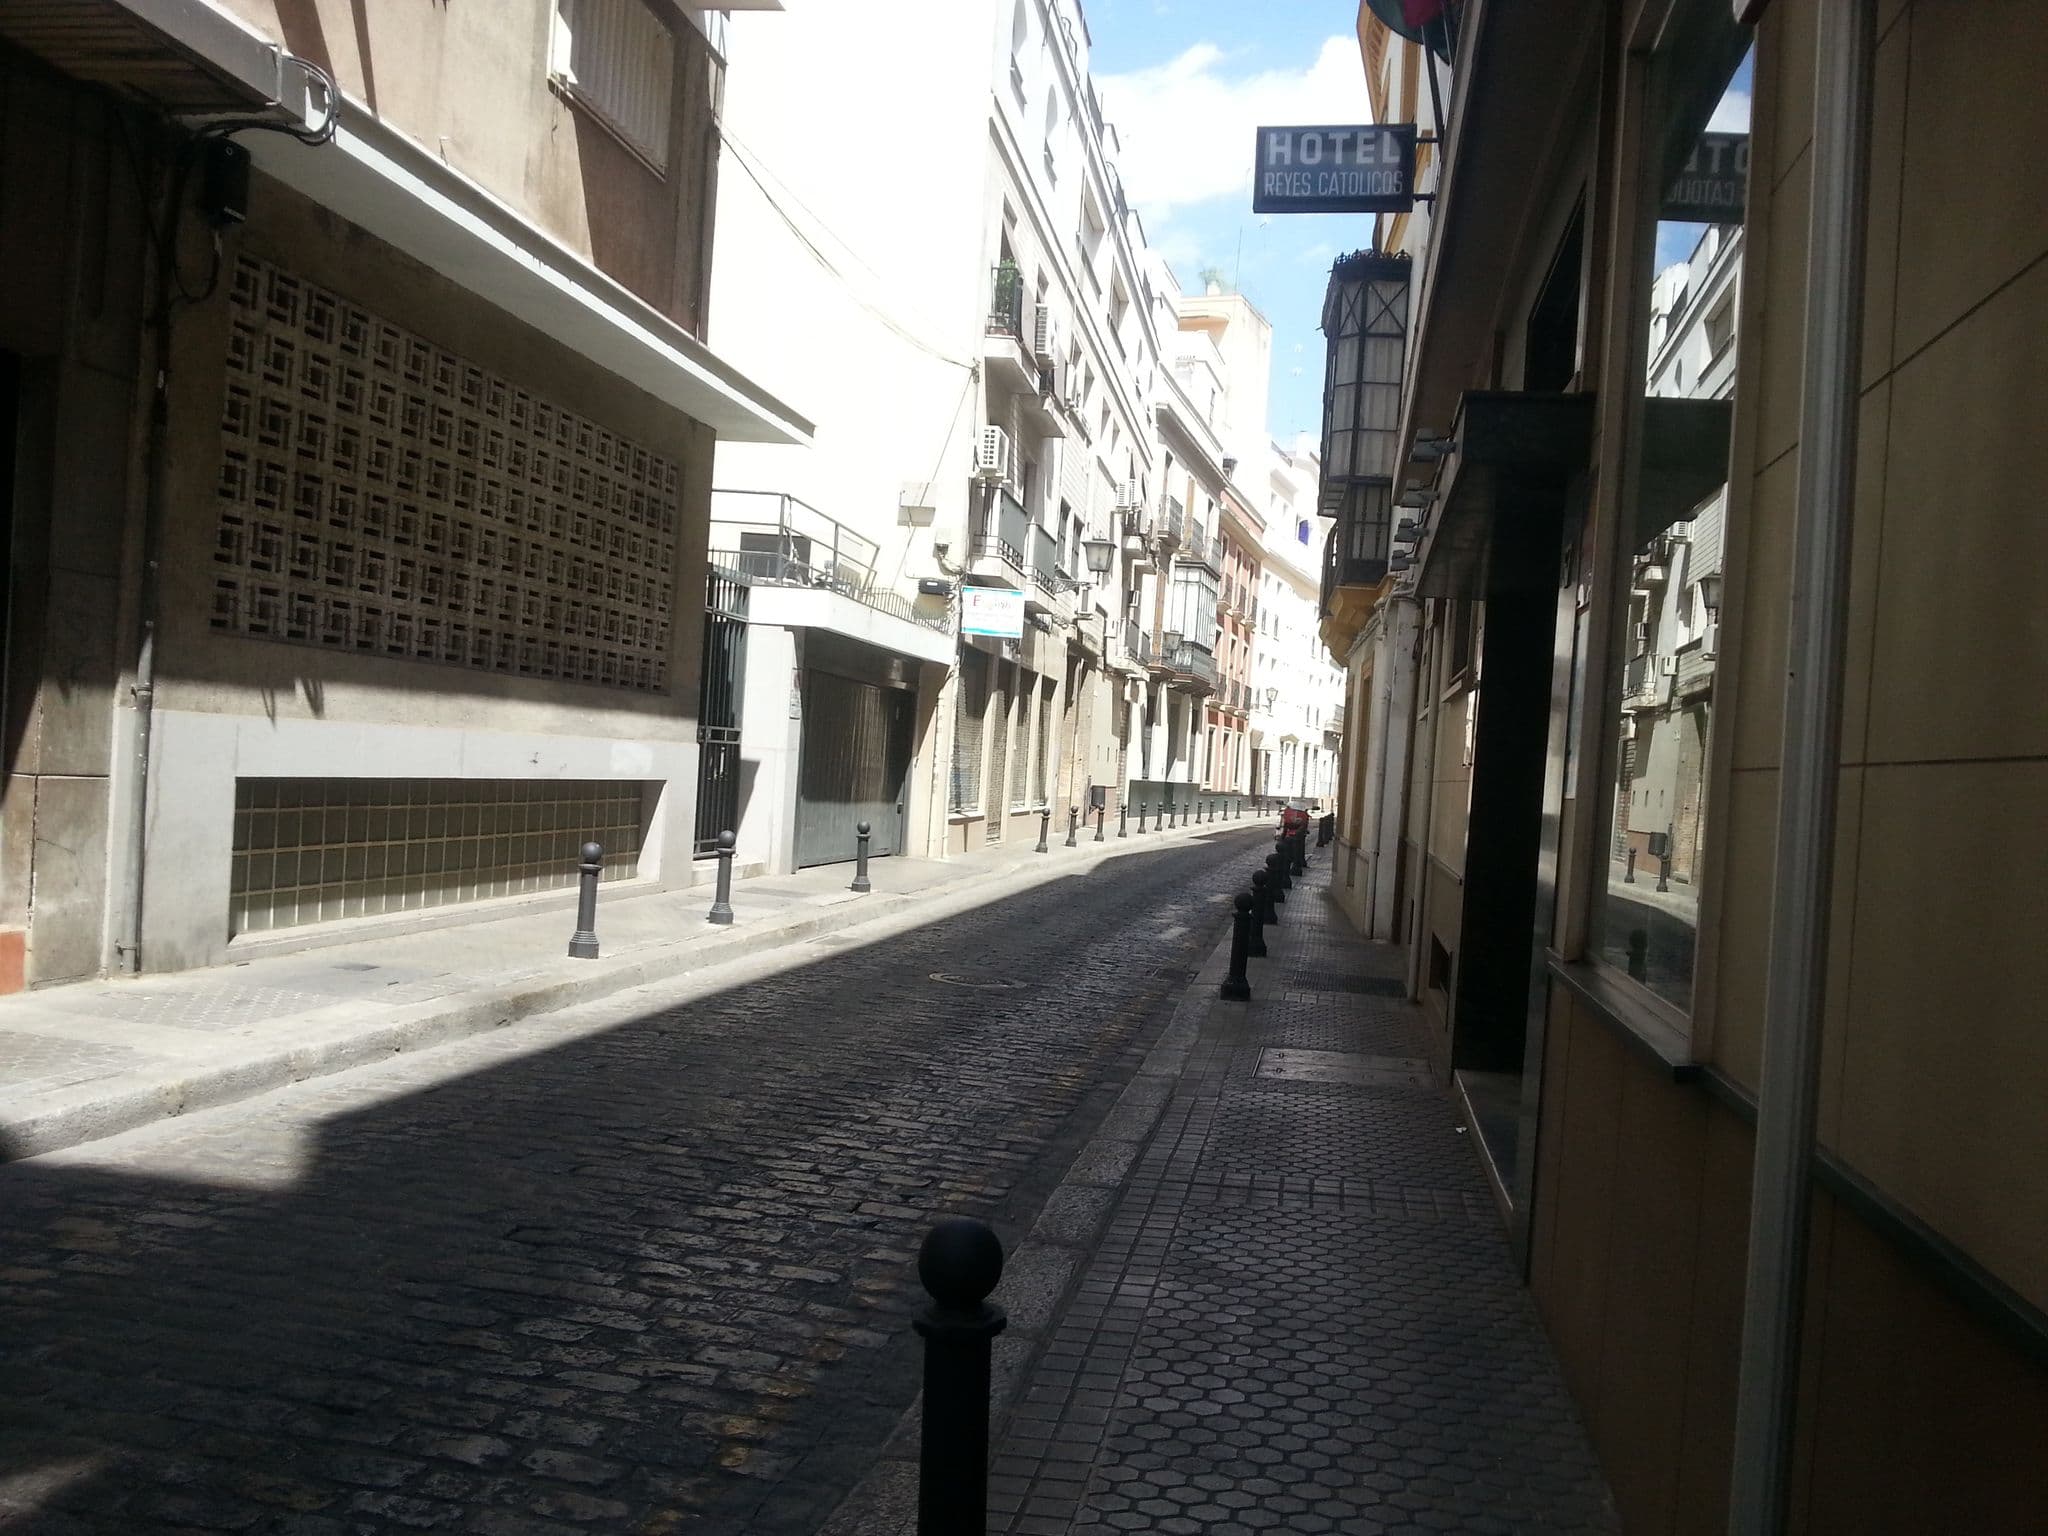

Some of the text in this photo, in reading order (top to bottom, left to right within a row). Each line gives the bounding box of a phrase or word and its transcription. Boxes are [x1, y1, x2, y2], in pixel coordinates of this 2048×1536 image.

[1266, 131, 1401, 166] HOTEL
[1264, 170, 1403, 196] REYES CATOLICOS
